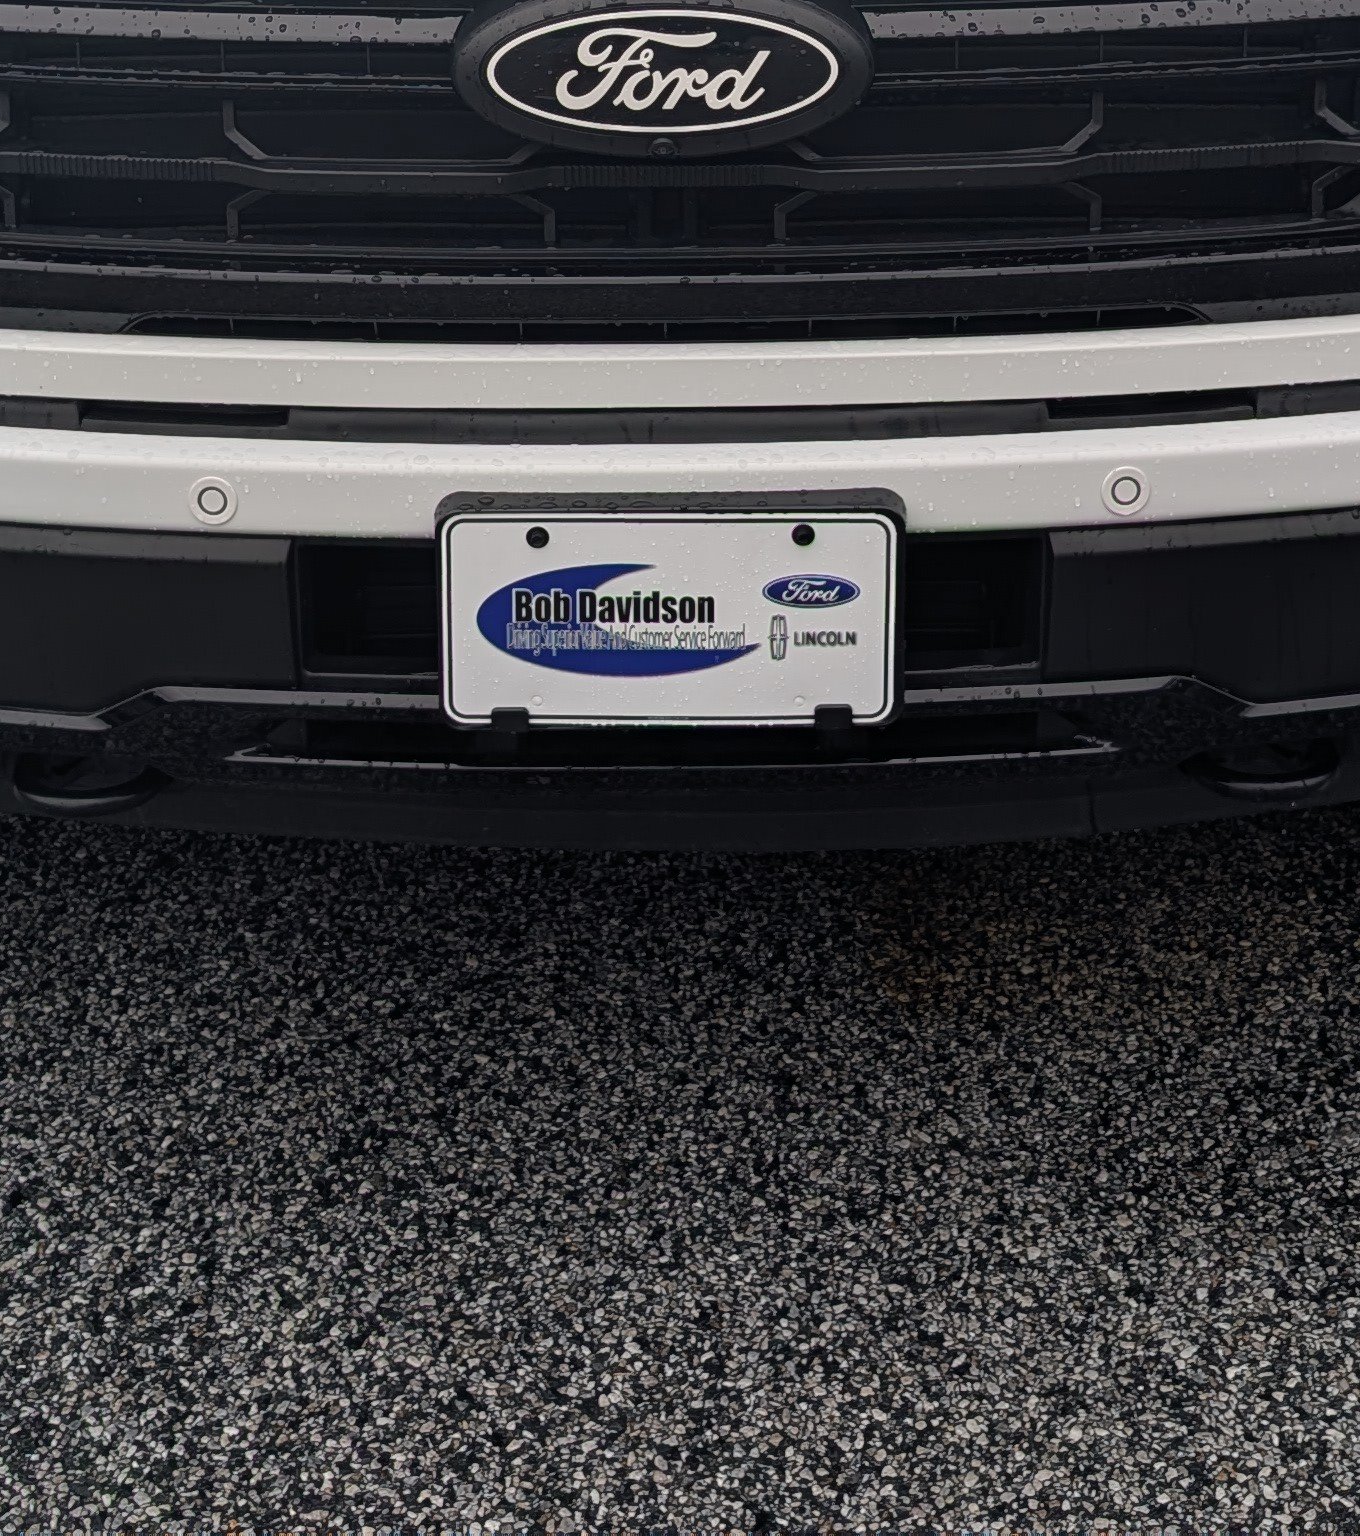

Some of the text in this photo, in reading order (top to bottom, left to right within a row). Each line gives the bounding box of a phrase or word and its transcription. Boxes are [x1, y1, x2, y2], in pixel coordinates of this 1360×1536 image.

[555, 27, 771, 111] Ford
[782, 578, 841, 603] Ford
[514, 590, 715, 624] Bob Davidson
[628, 624, 673, 650] Customer
[674, 624, 706, 650] Service
[707, 623, 746, 650] Forward
[794, 630, 857, 647] LINCOLN
